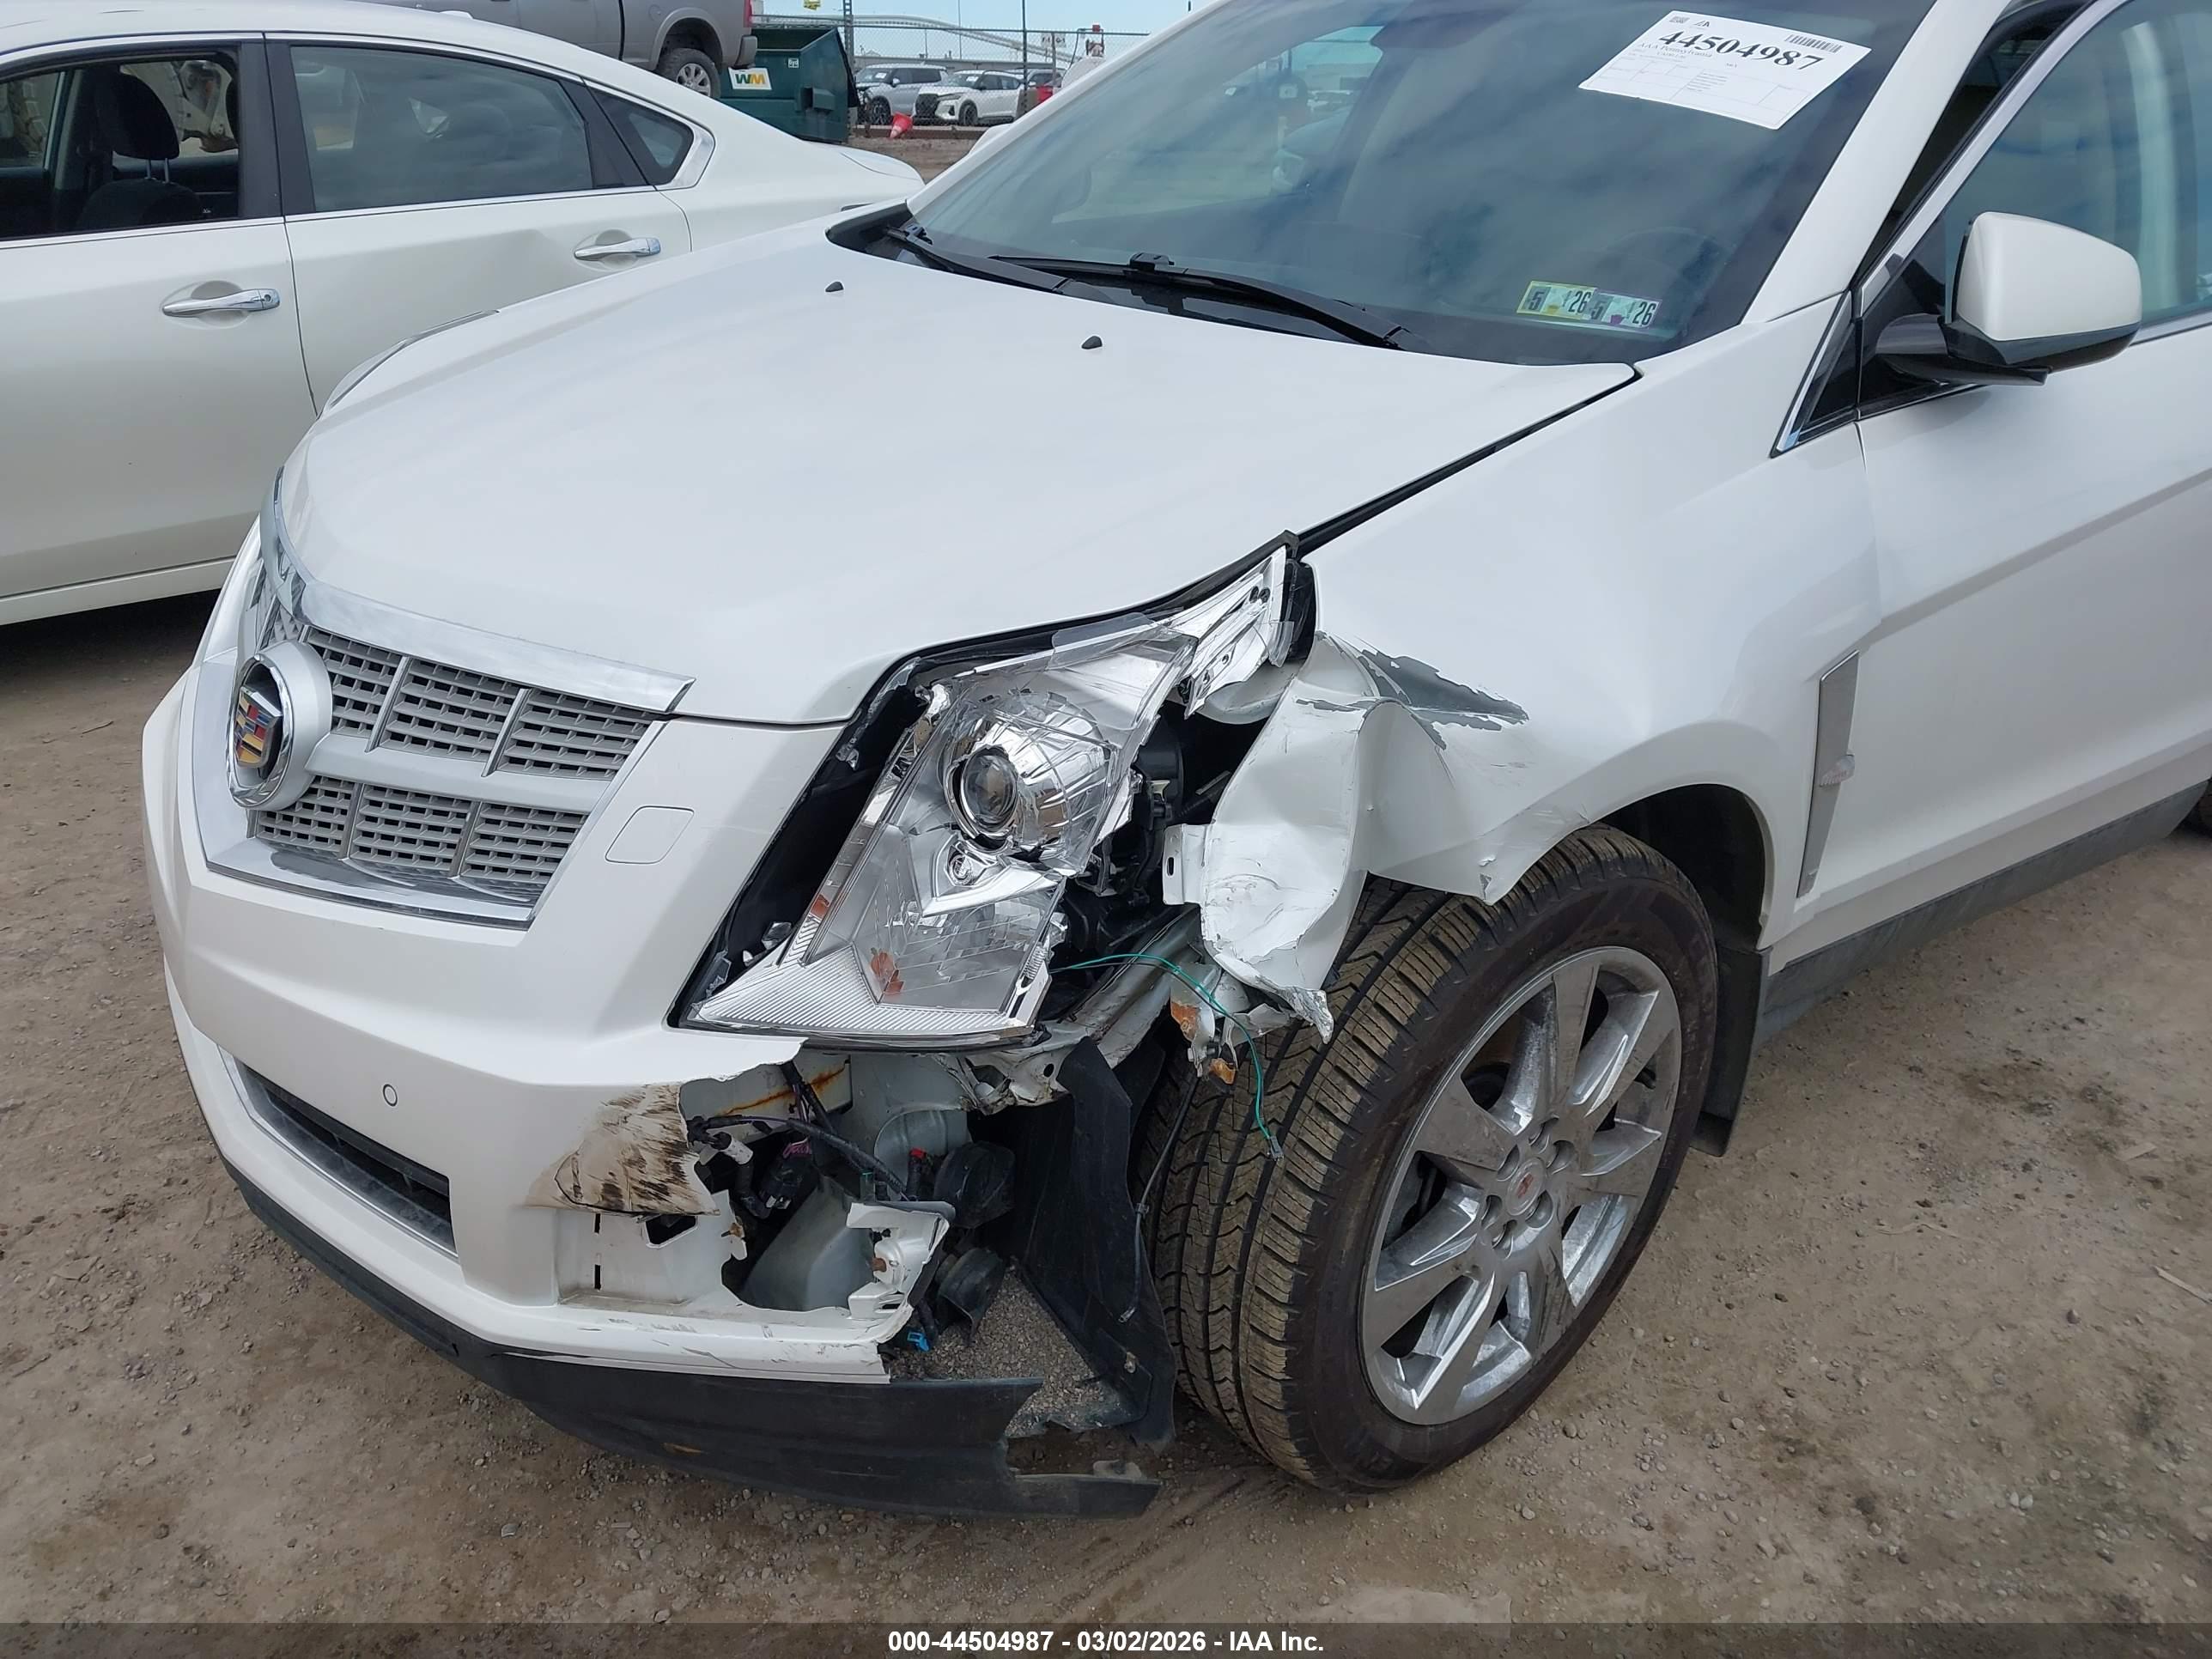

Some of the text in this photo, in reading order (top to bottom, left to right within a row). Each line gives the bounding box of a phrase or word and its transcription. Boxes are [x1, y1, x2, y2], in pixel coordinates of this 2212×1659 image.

[1658, 31, 1824, 70] 44504987
[735, 73, 766, 84] WM
[1528, 290, 1544, 311] 5
[1568, 290, 1591, 314] 26
[1632, 301, 1656, 326] 26
